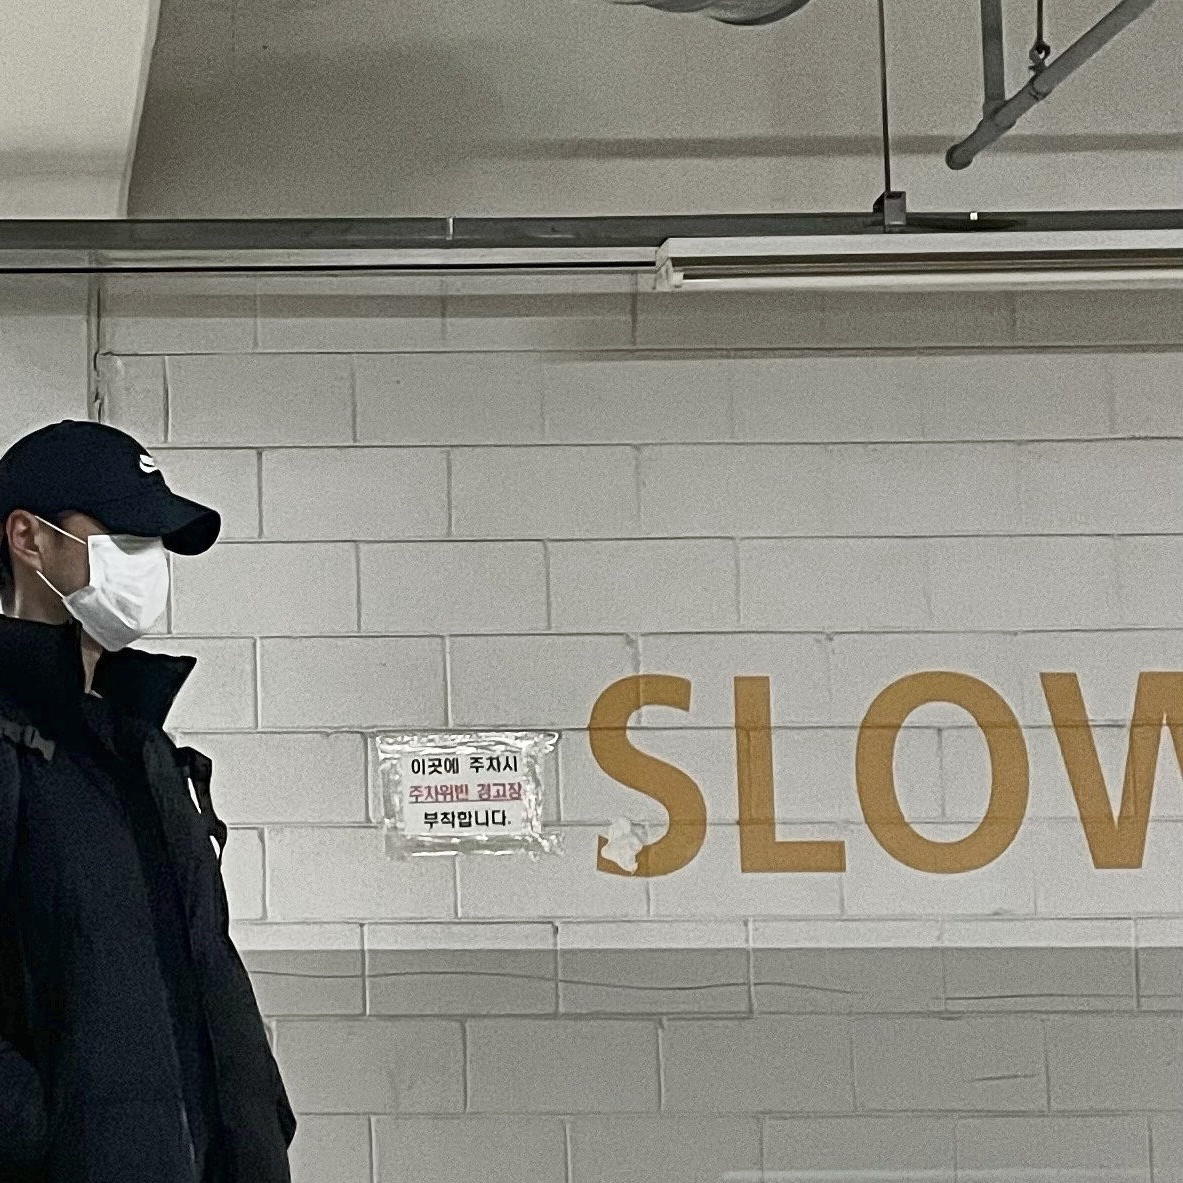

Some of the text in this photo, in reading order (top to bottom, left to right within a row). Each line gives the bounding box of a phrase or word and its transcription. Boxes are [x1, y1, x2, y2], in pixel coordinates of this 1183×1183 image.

[411, 755, 518, 774] 이곳에 주차시
[588, 670, 1183, 878] SLOW
[409, 781, 523, 802] 주차위반 경고장
[423, 809, 512, 829] 부착합니다.
